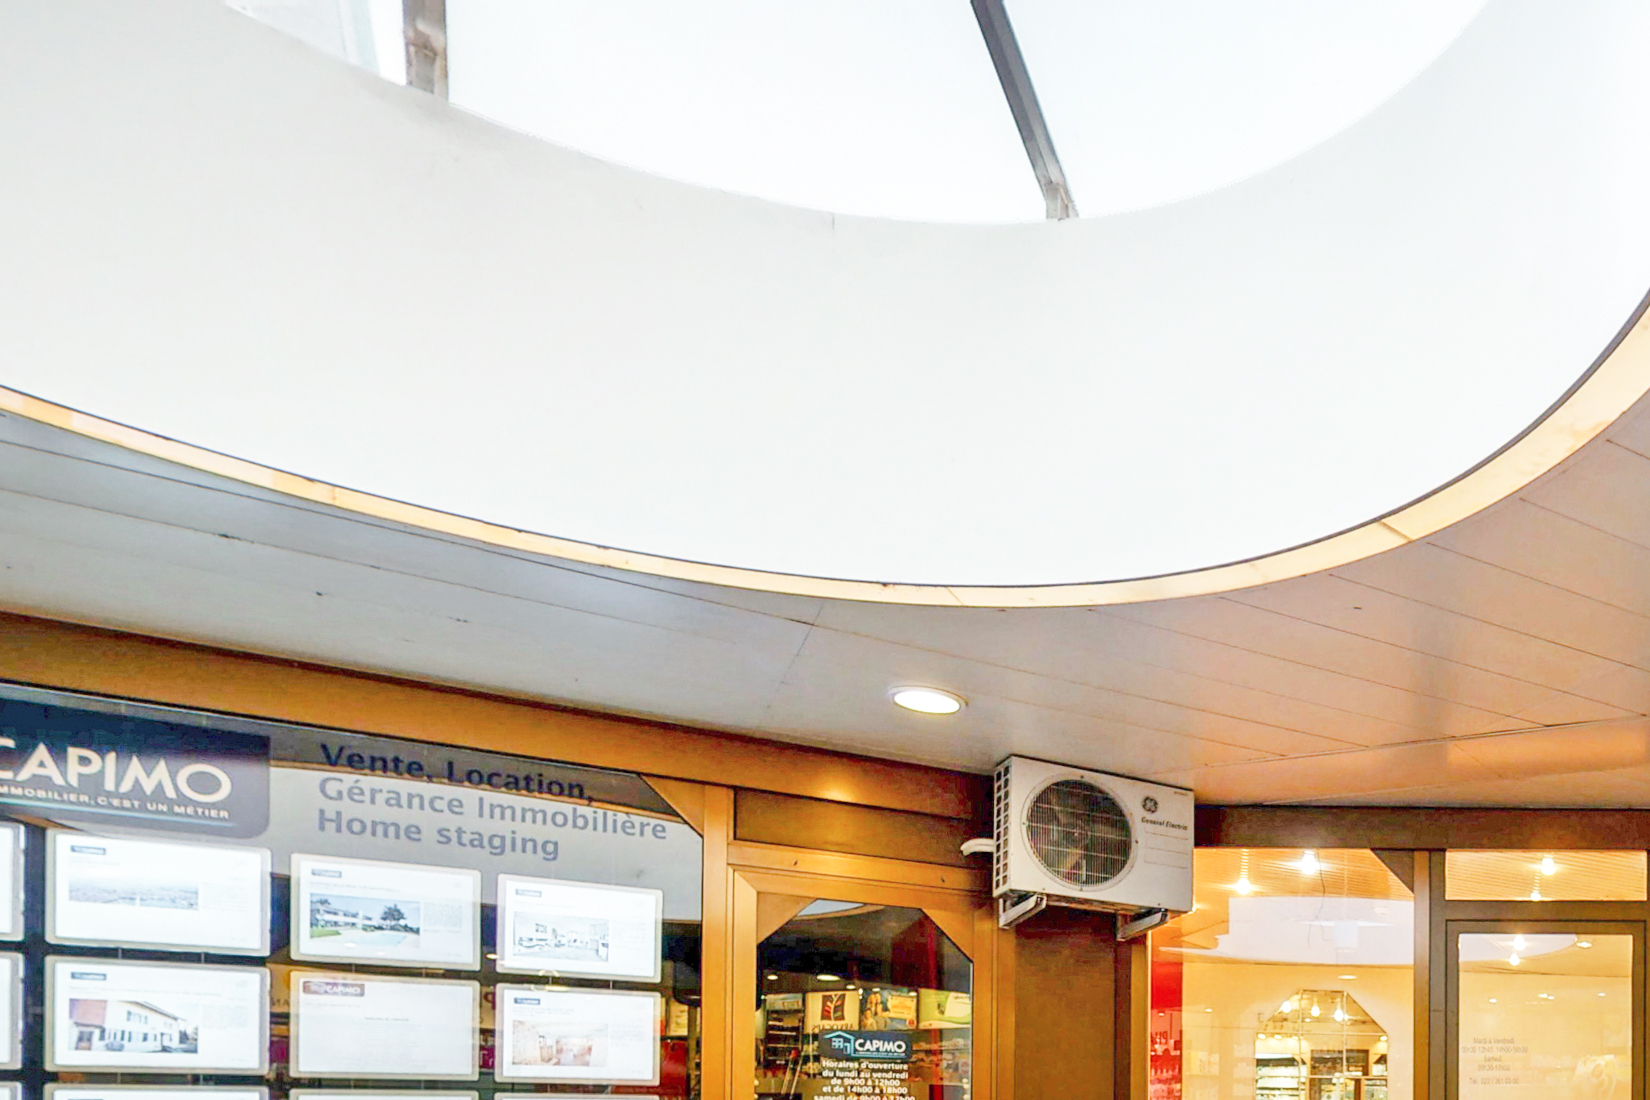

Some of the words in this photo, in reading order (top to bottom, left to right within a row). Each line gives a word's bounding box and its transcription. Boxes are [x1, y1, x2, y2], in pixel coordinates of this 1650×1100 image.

[320, 744, 432, 782] Vente,
[446, 760, 593, 806] Location,
[96, 795, 140, 809] C'EST
[146, 801, 168, 812] UN
[173, 803, 229, 819] MÉTIER
[319, 776, 465, 815] Gérance
[477, 797, 667, 840] Immobilière
[1141, 817, 1165, 826] General
[1165, 821, 1188, 831] Electric
[318, 808, 422, 841] Home
[436, 826, 560, 861] staging
[855, 1039, 906, 1053] CAPIMO
[860, 1062, 908, 1070] d'ouverture
[872, 1071, 908, 1079] vendredi
